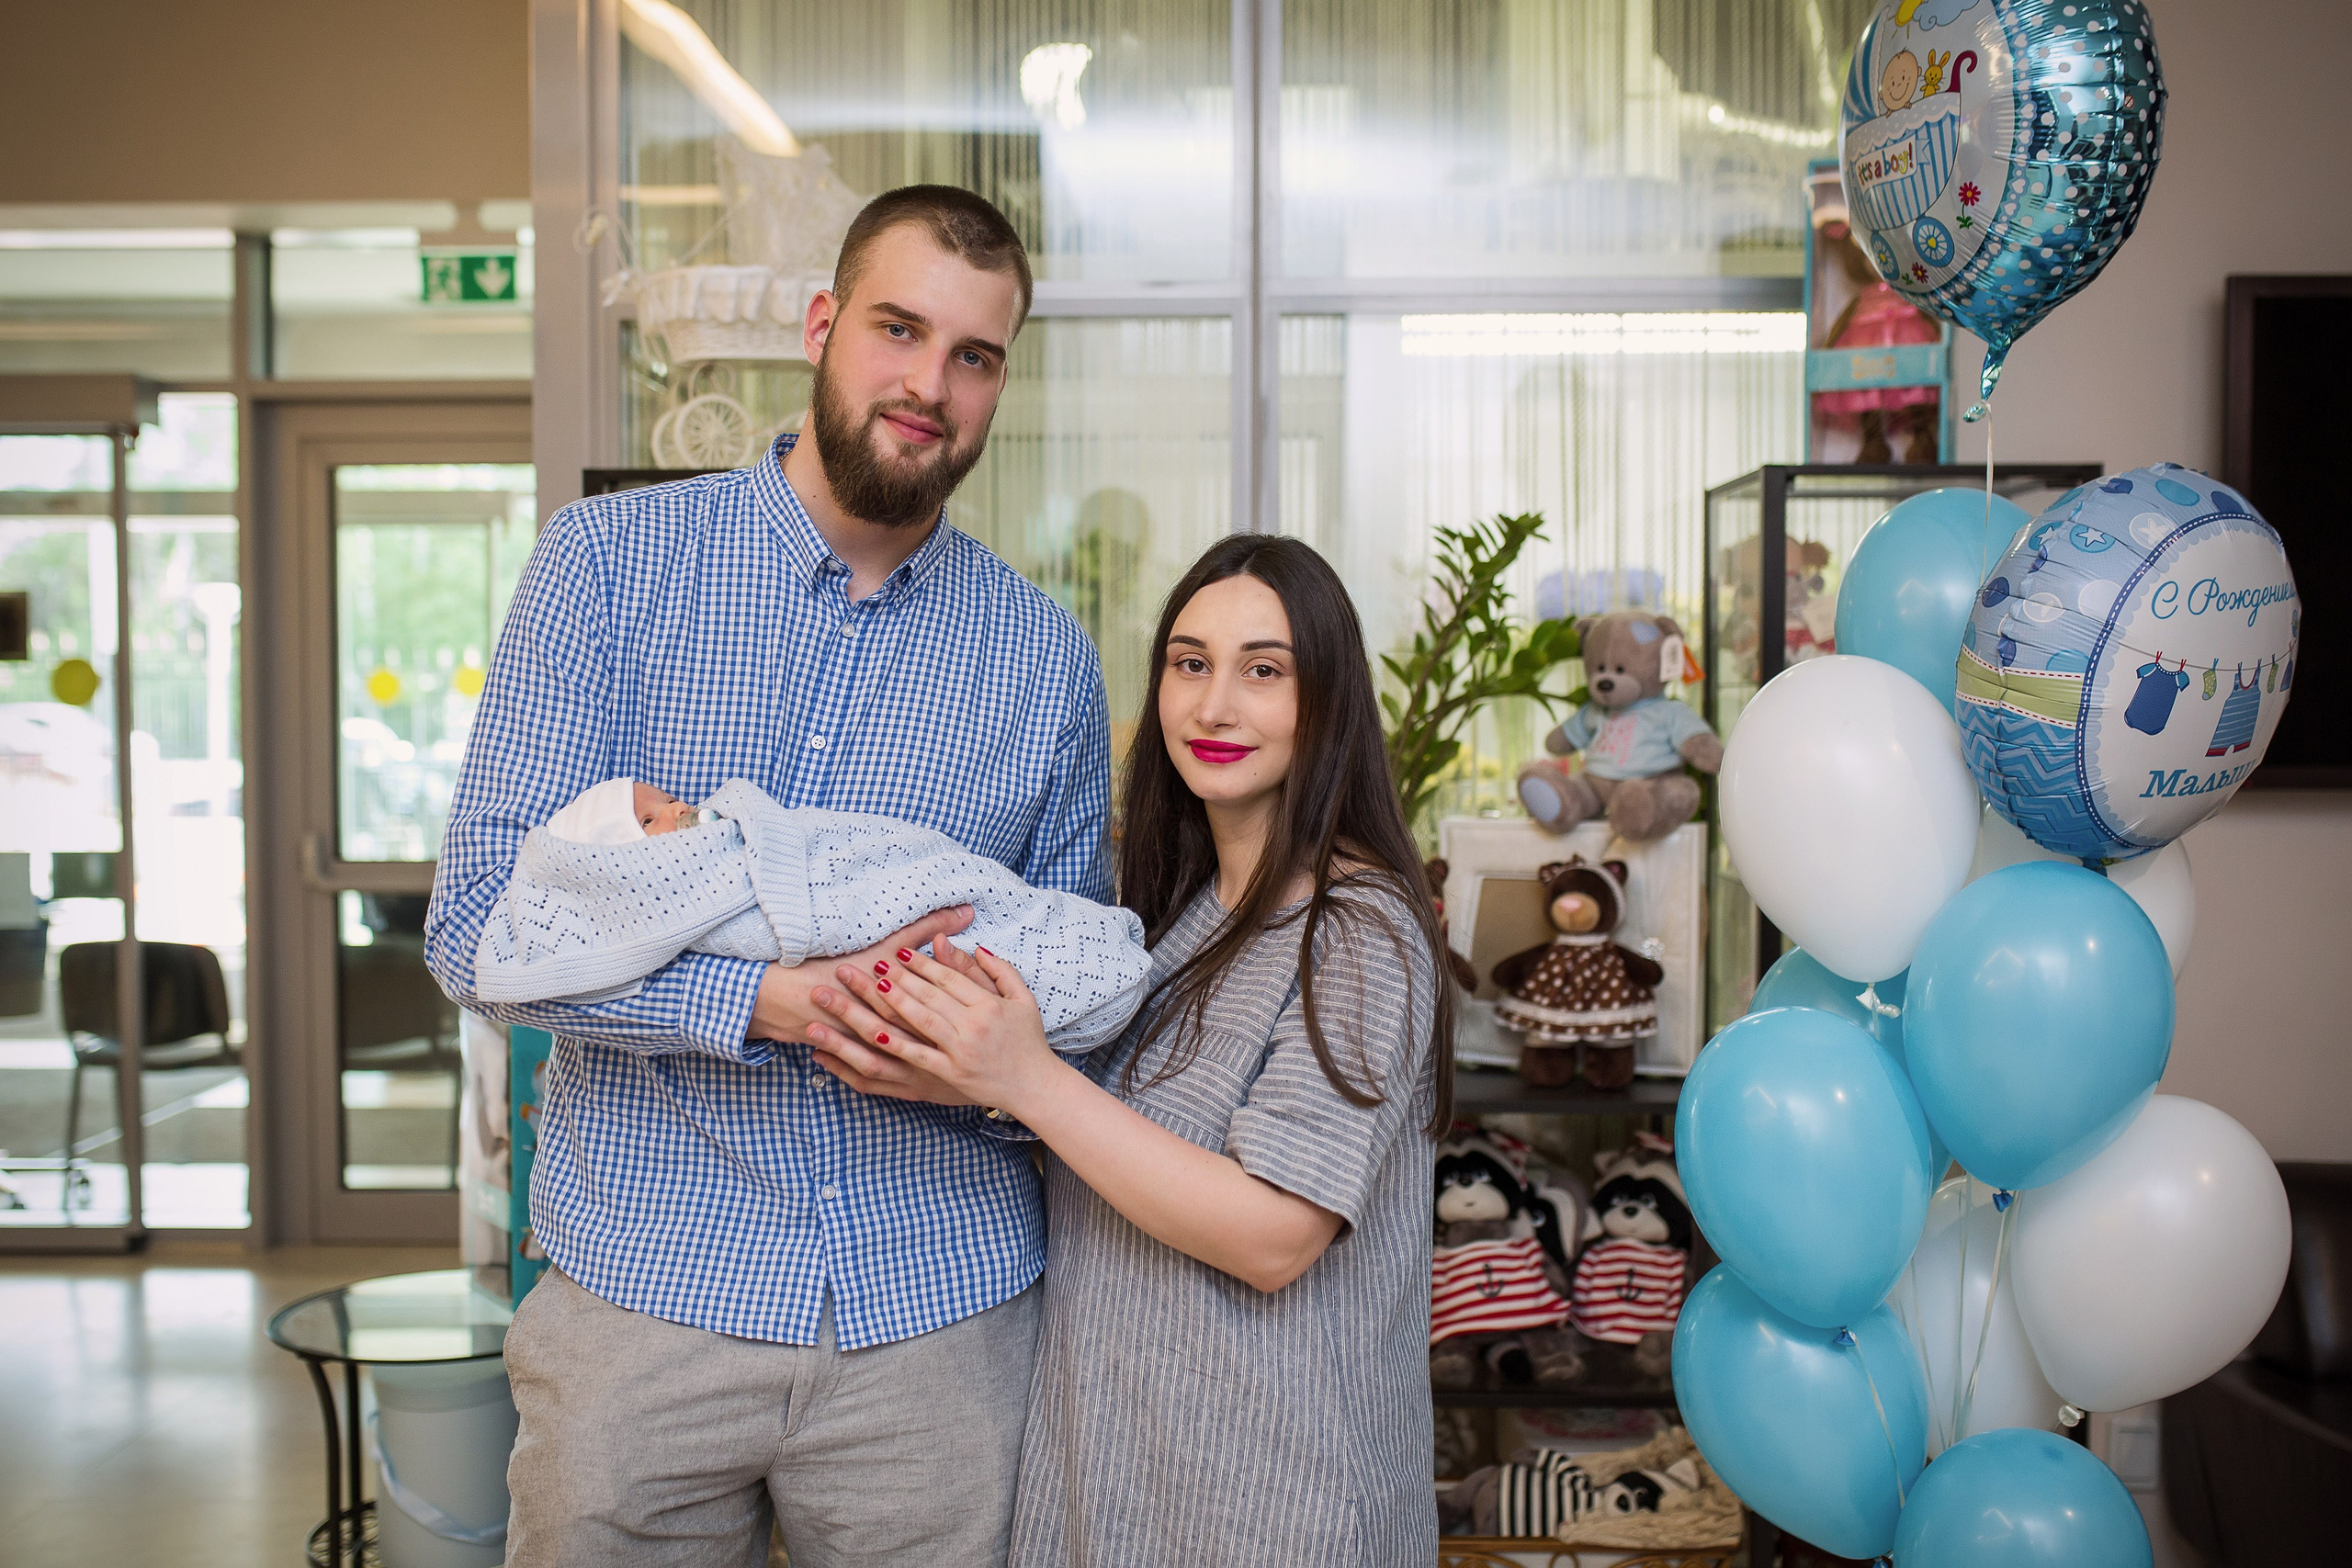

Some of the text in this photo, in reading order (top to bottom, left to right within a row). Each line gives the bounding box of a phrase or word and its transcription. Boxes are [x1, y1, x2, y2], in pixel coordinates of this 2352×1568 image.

[1874, 159, 1883, 178] a
[1882, 141, 1914, 176] boy!
[2151, 581, 2179, 620] С
